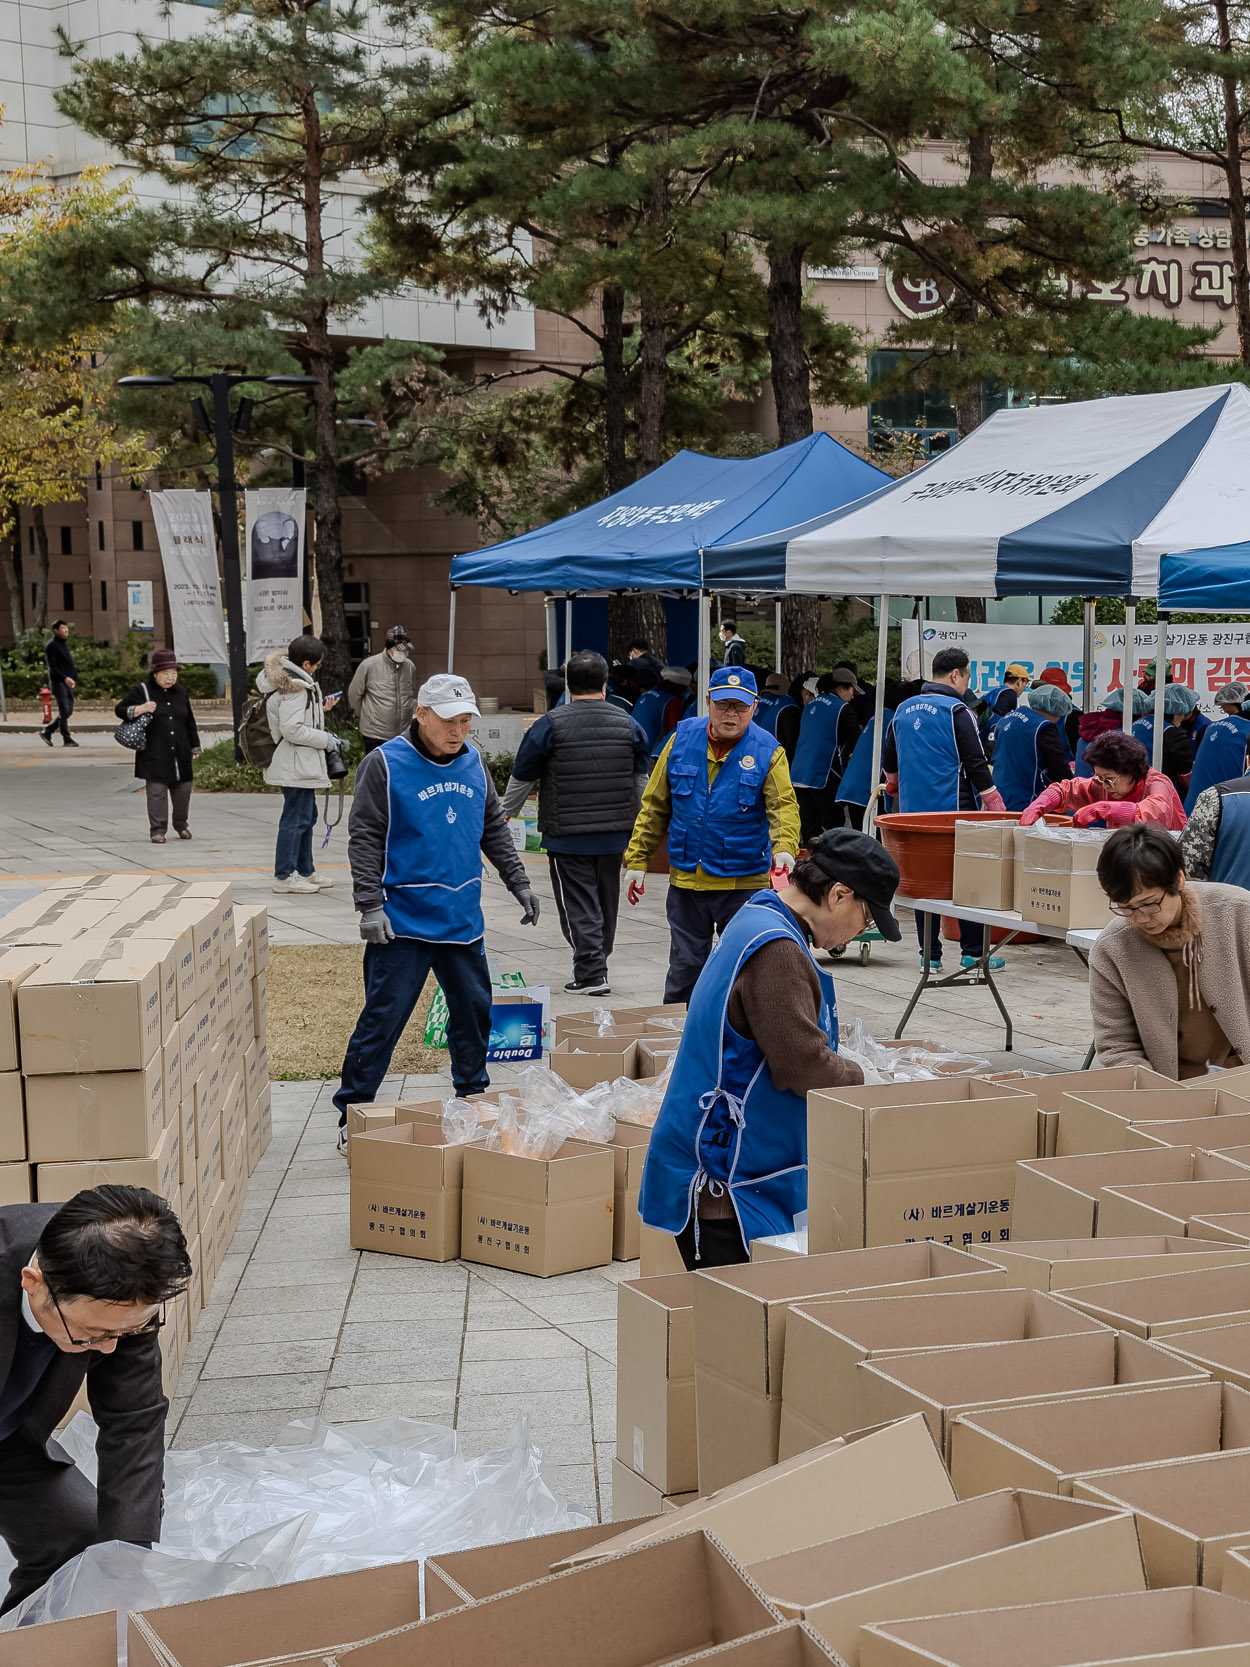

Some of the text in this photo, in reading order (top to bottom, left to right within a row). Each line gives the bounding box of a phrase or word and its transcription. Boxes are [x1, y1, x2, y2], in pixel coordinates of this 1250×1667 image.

[1156, 224, 1191, 248] 가족
[169, 513, 198, 522] 2023
[937, 631, 968, 641] 광진구
[417, 781, 474, 801] 바르게살기운동
[493, 1048, 533, 1060] Double
[368, 1203, 427, 1221] (사) 바르게살기운동
[903, 1198, 1010, 1222] (사) 바르게살기운동
[477, 1215, 530, 1236] (사) 바르게살기운동
